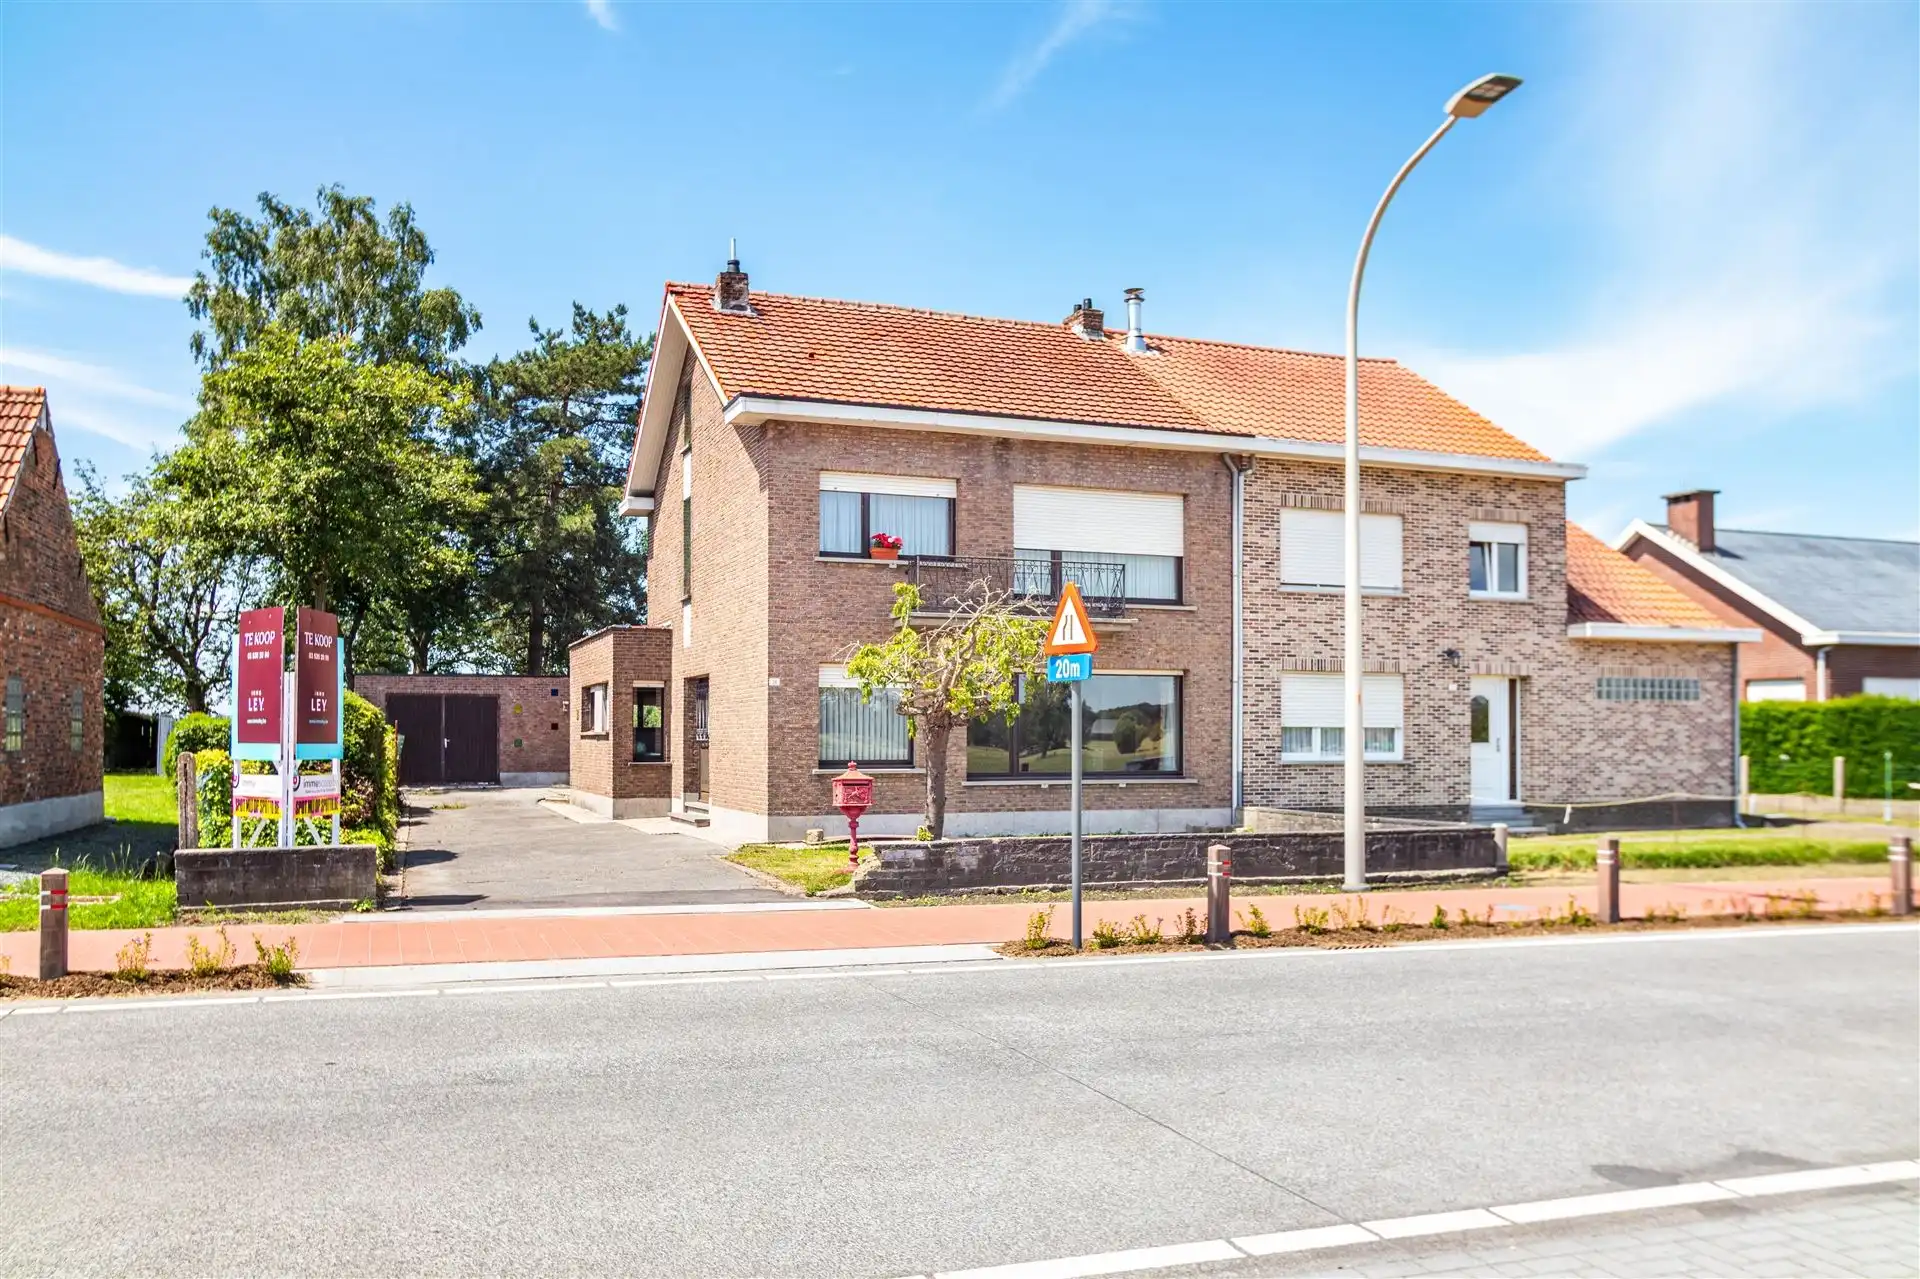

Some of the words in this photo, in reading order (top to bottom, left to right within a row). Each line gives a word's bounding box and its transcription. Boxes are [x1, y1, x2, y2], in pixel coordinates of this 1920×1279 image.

[245, 632, 254, 646] TE
[254, 630, 276, 645] KOOP
[304, 631, 314, 645] TE
[314, 633, 333, 648] KOOP
[1055, 658, 1081, 679] 20m
